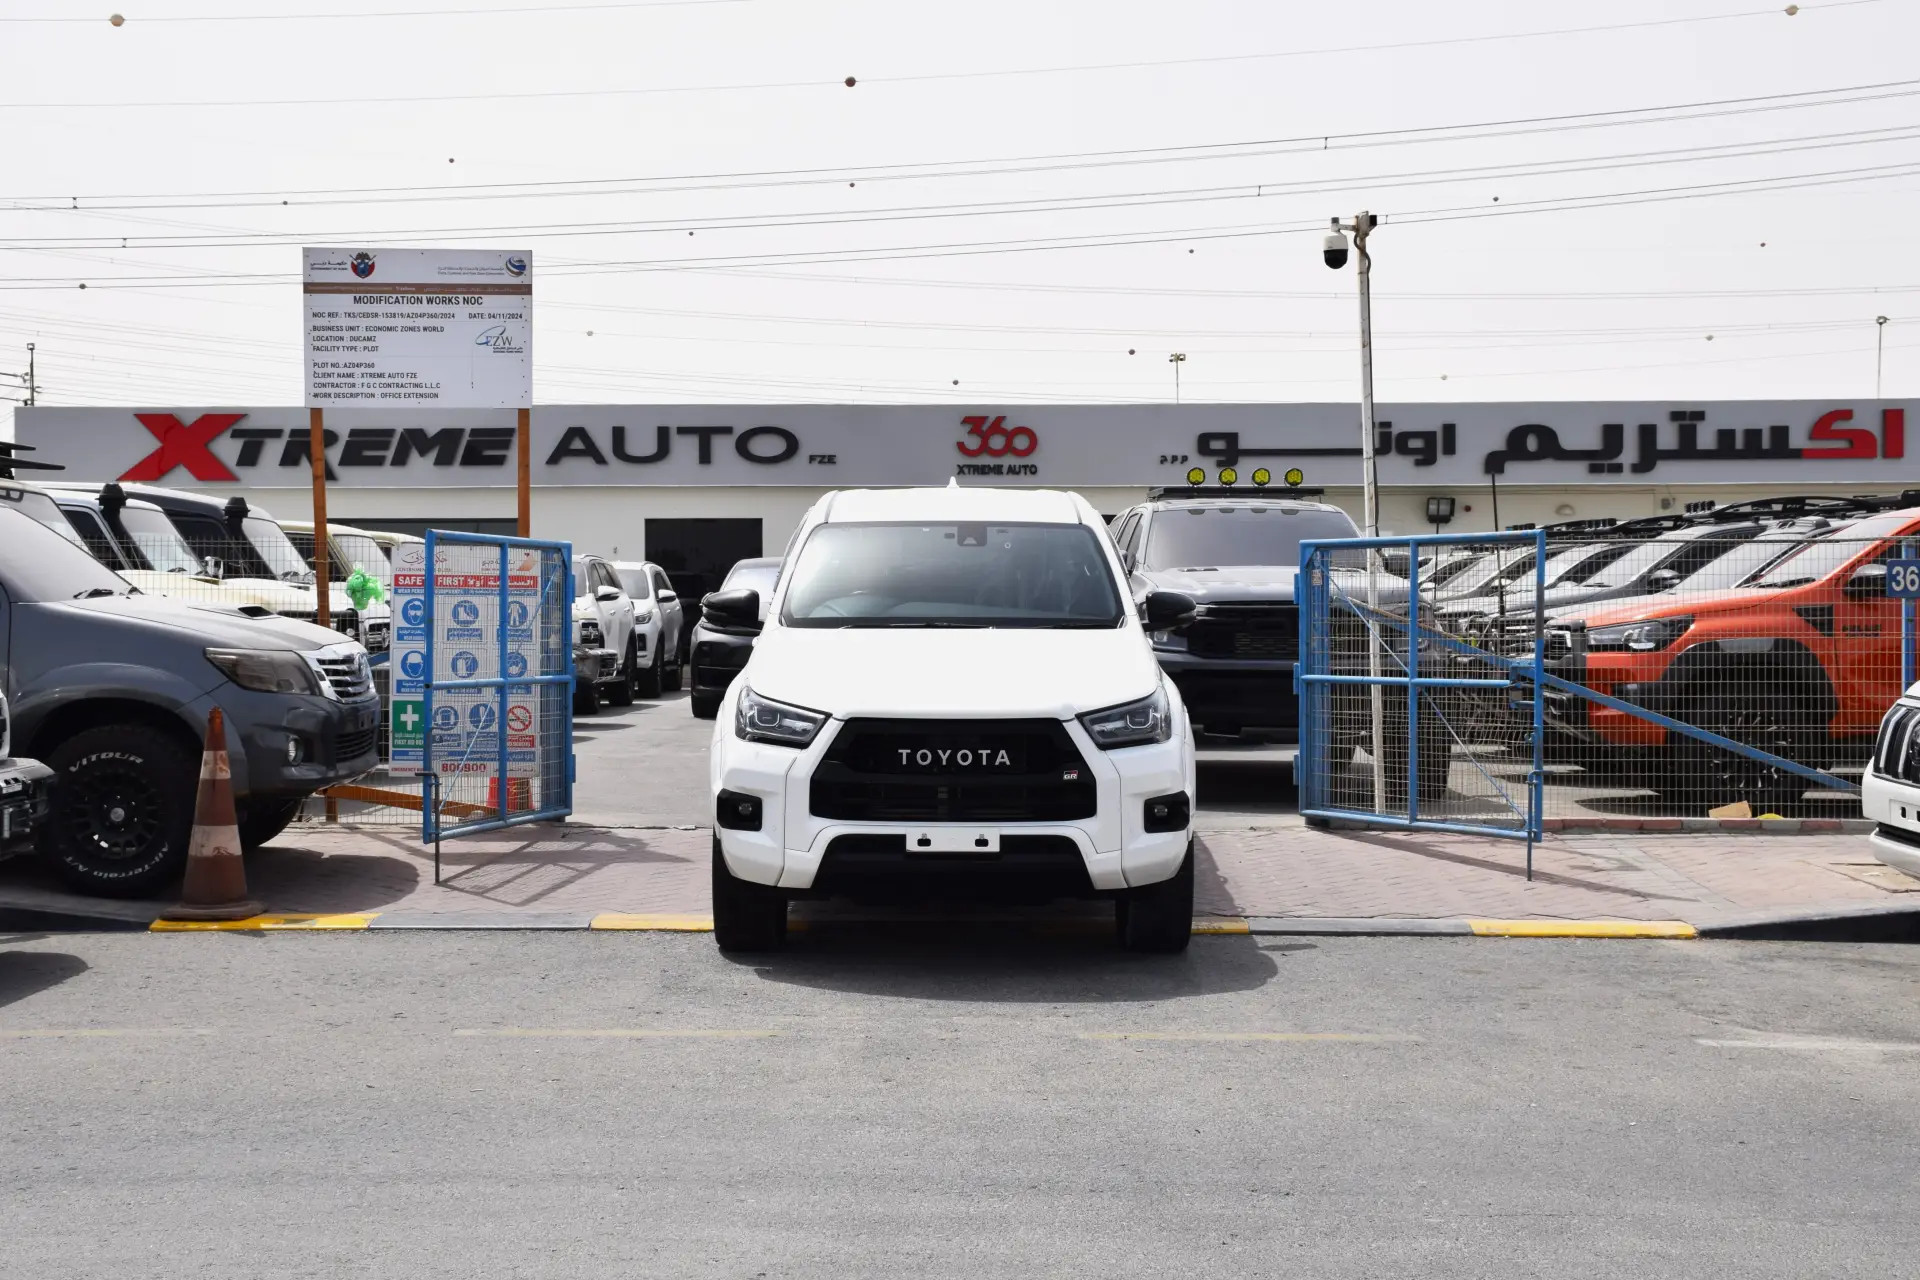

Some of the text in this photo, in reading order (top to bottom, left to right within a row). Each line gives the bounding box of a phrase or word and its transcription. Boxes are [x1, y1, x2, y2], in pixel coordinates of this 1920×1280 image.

[353, 296, 483, 305] MODIFICATION WORKS NOC
[486, 336, 512, 346] EZW
[956, 416, 1038, 458] 360
[1484, 408, 1904, 474] اكستريم
[116, 413, 837, 481] XTREME AUTO FZE
[956, 464, 1038, 476] XTREME AUTO
[398, 576, 464, 586] SAFE FIRST
[69, 752, 144, 772] VITOUR
[898, 749, 1010, 766] TOYOTA
[442, 763, 486, 772] 800900
